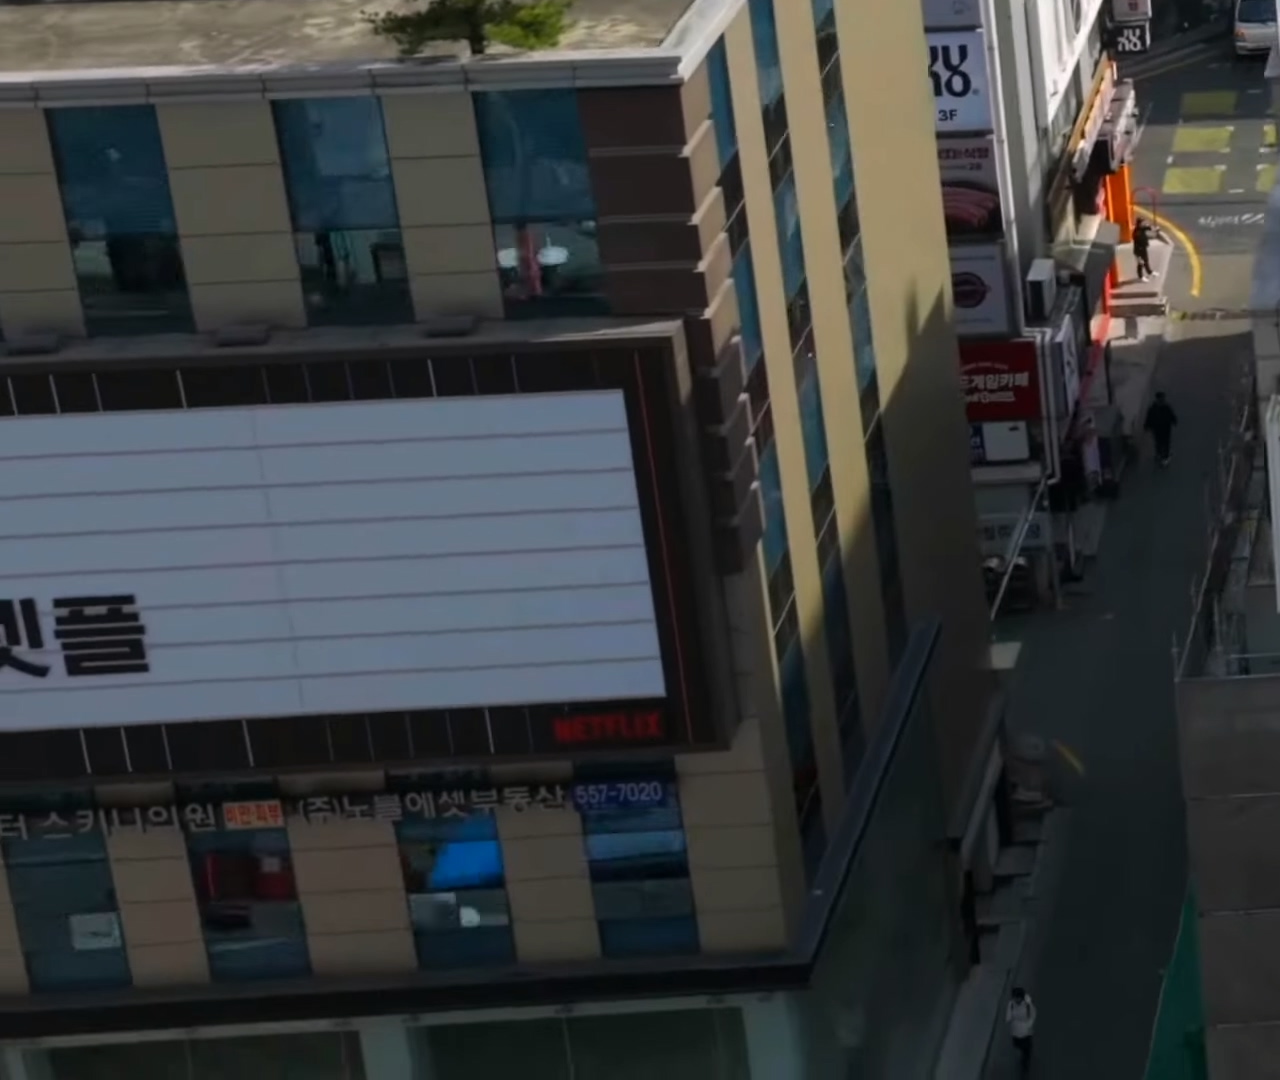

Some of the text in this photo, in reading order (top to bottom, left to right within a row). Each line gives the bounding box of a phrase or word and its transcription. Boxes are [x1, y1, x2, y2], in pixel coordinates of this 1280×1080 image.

[938, 109, 958, 122] 3F
[554, 711, 662, 742] NETFLIX
[575, 781, 662, 804] 557-7020
